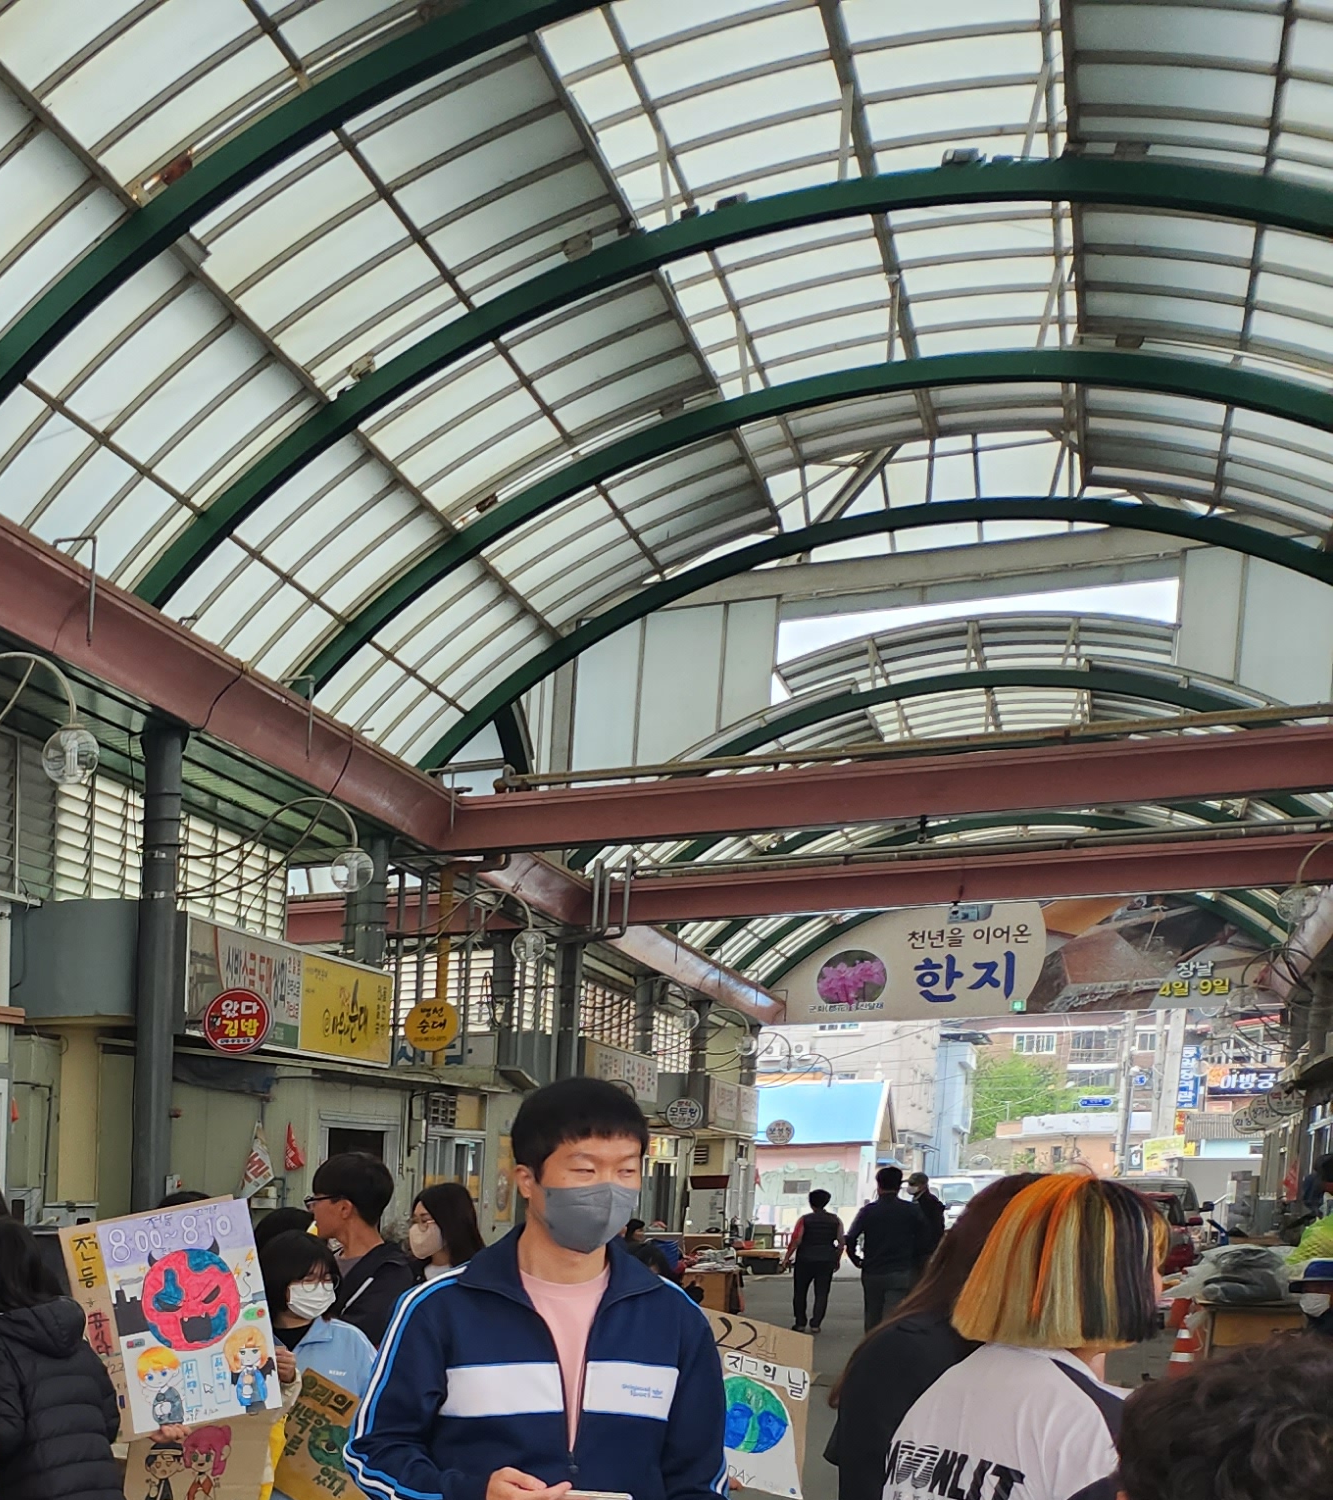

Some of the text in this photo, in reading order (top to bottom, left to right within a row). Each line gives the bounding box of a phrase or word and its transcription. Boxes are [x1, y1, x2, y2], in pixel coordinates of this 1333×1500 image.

[907, 924, 1032, 949] 천년을 이어온
[913, 951, 1016, 1002] 한지
[1176, 960, 1215, 978] 장날
[221, 1000, 260, 1018] 왔다
[221, 1018, 260, 1037] 김밥
[416, 1018, 449, 1034] 순대
